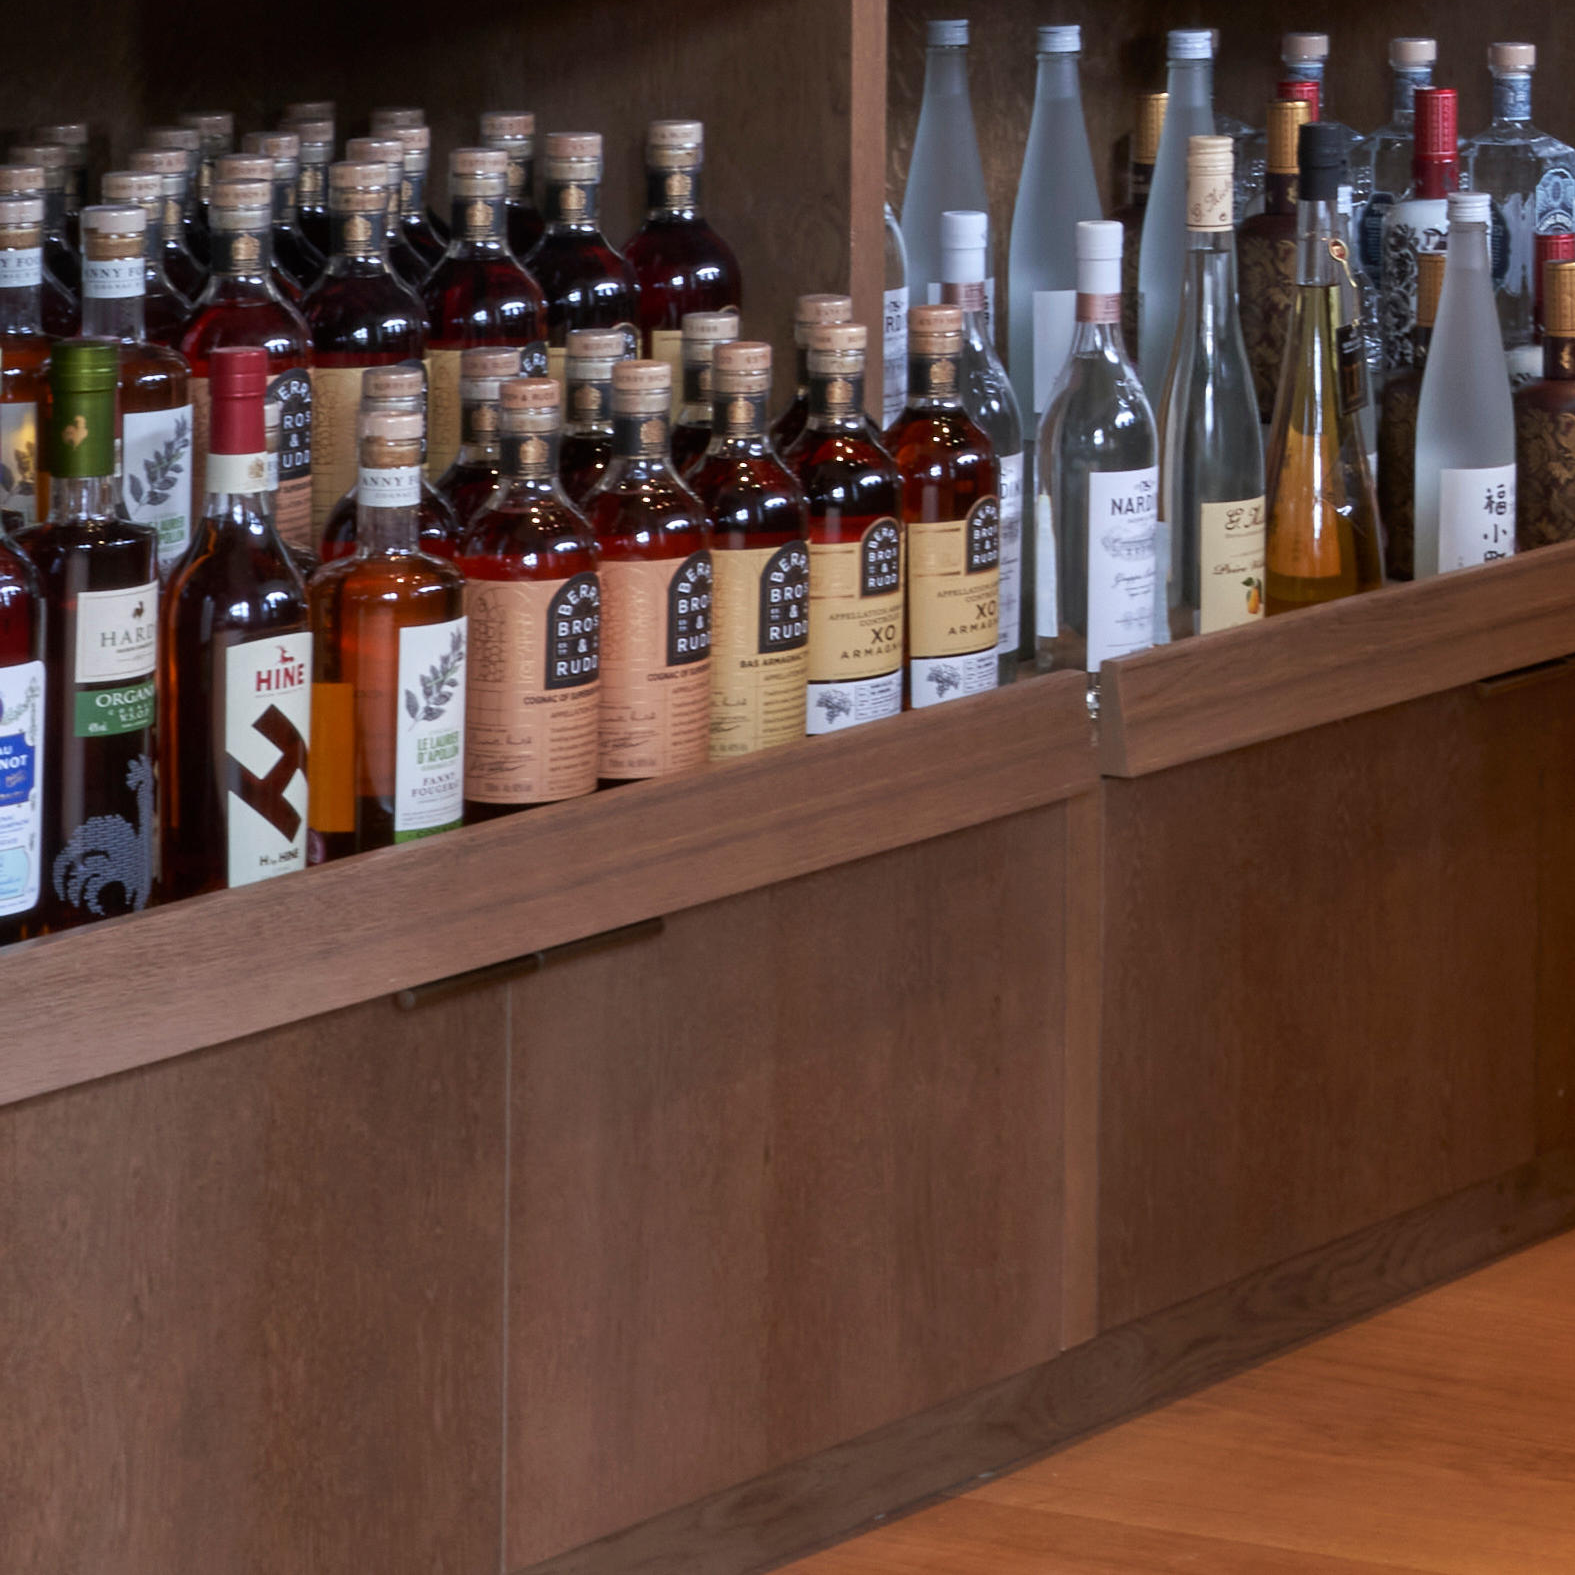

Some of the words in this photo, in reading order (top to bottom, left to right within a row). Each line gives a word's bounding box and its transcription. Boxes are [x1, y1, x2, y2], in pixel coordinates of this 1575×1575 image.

[276, 380, 312, 403] ERRY
[283, 410, 311, 430] ROS
[288, 433, 299, 448] &
[281, 449, 311, 468] UDD
[880, 562, 889, 573] &
[789, 604, 799, 618] &
[975, 600, 998, 620] XO
[695, 615, 704, 629] &
[769, 620, 808, 641] RUDD
[871, 624, 896, 645] XO
[577, 638, 587, 653] &
[556, 654, 598, 676] RUDD
[254, 663, 305, 693] HINE
